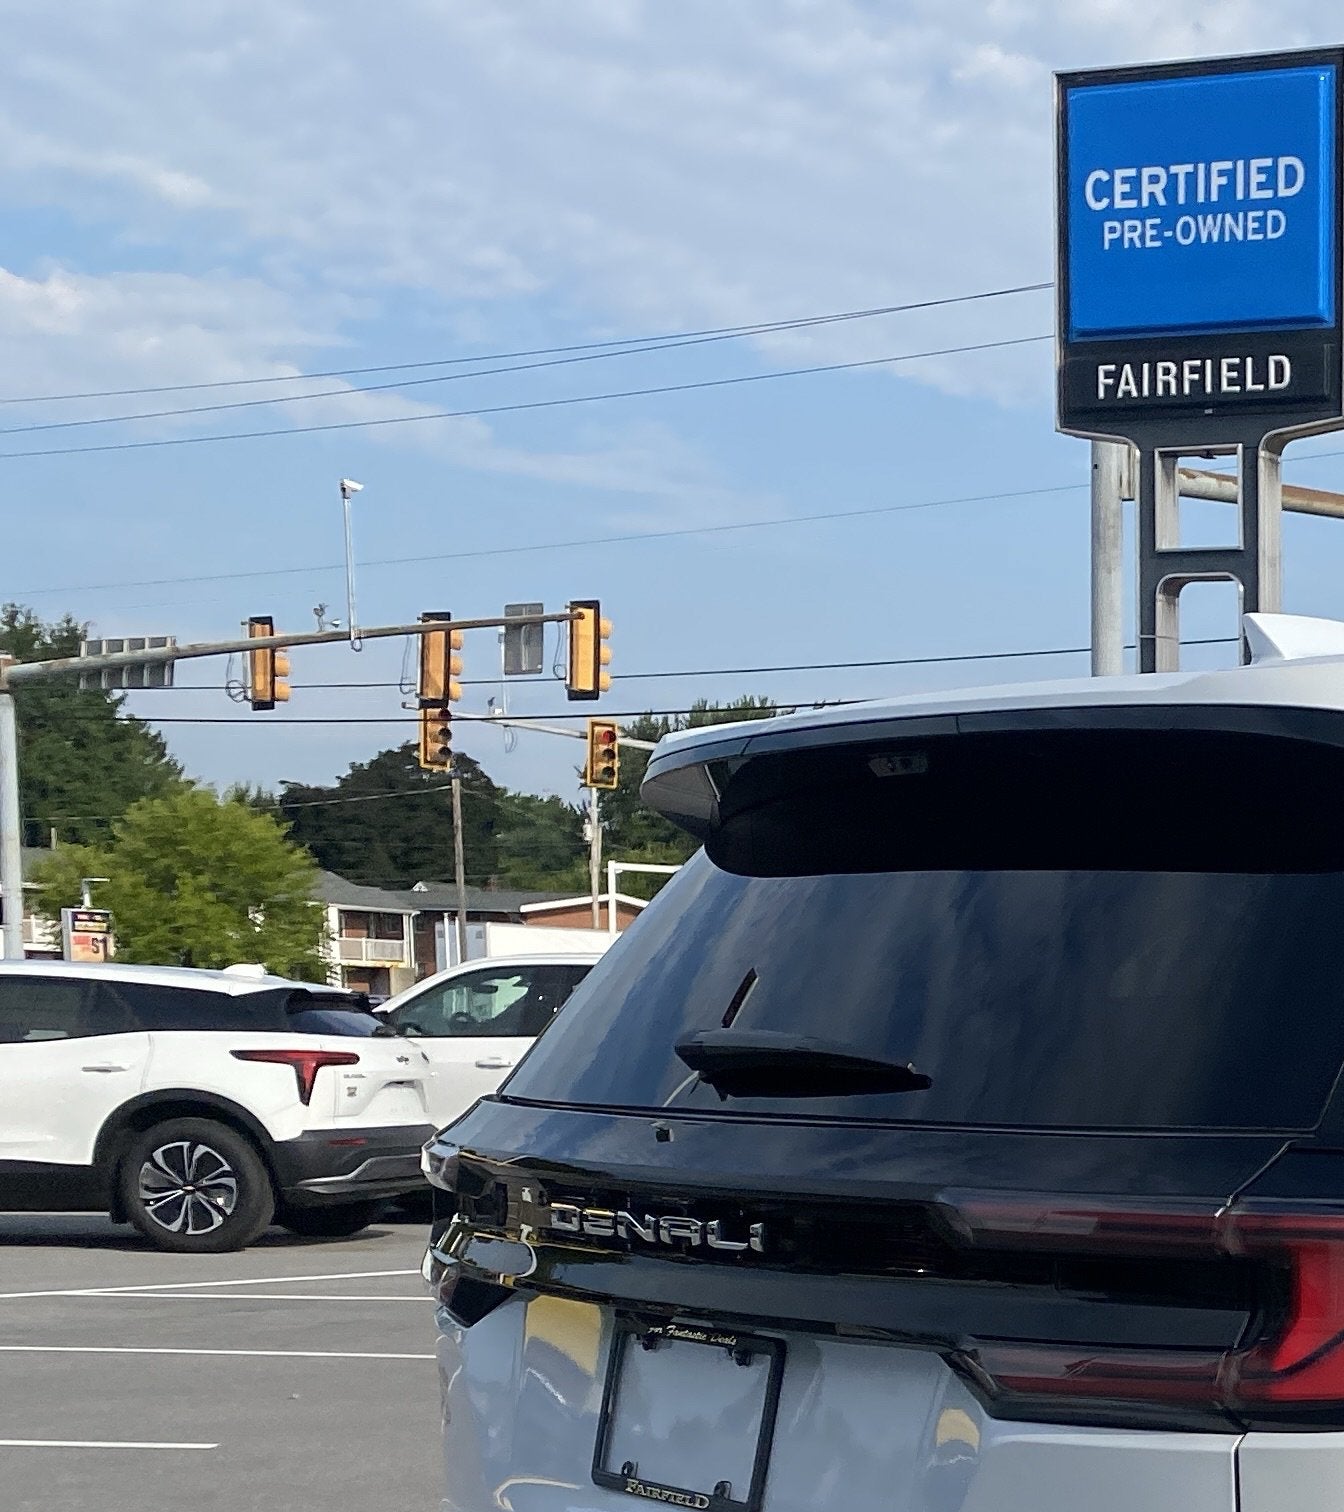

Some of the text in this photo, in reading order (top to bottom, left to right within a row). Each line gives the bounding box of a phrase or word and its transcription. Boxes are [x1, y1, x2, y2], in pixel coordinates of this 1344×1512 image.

[1084, 156, 1305, 211] CERTIFIED
[1102, 209, 1288, 250] PRE-OWNED
[1097, 354, 1292, 400] FAIRFIELD
[551, 1202, 765, 1252] DENALI
